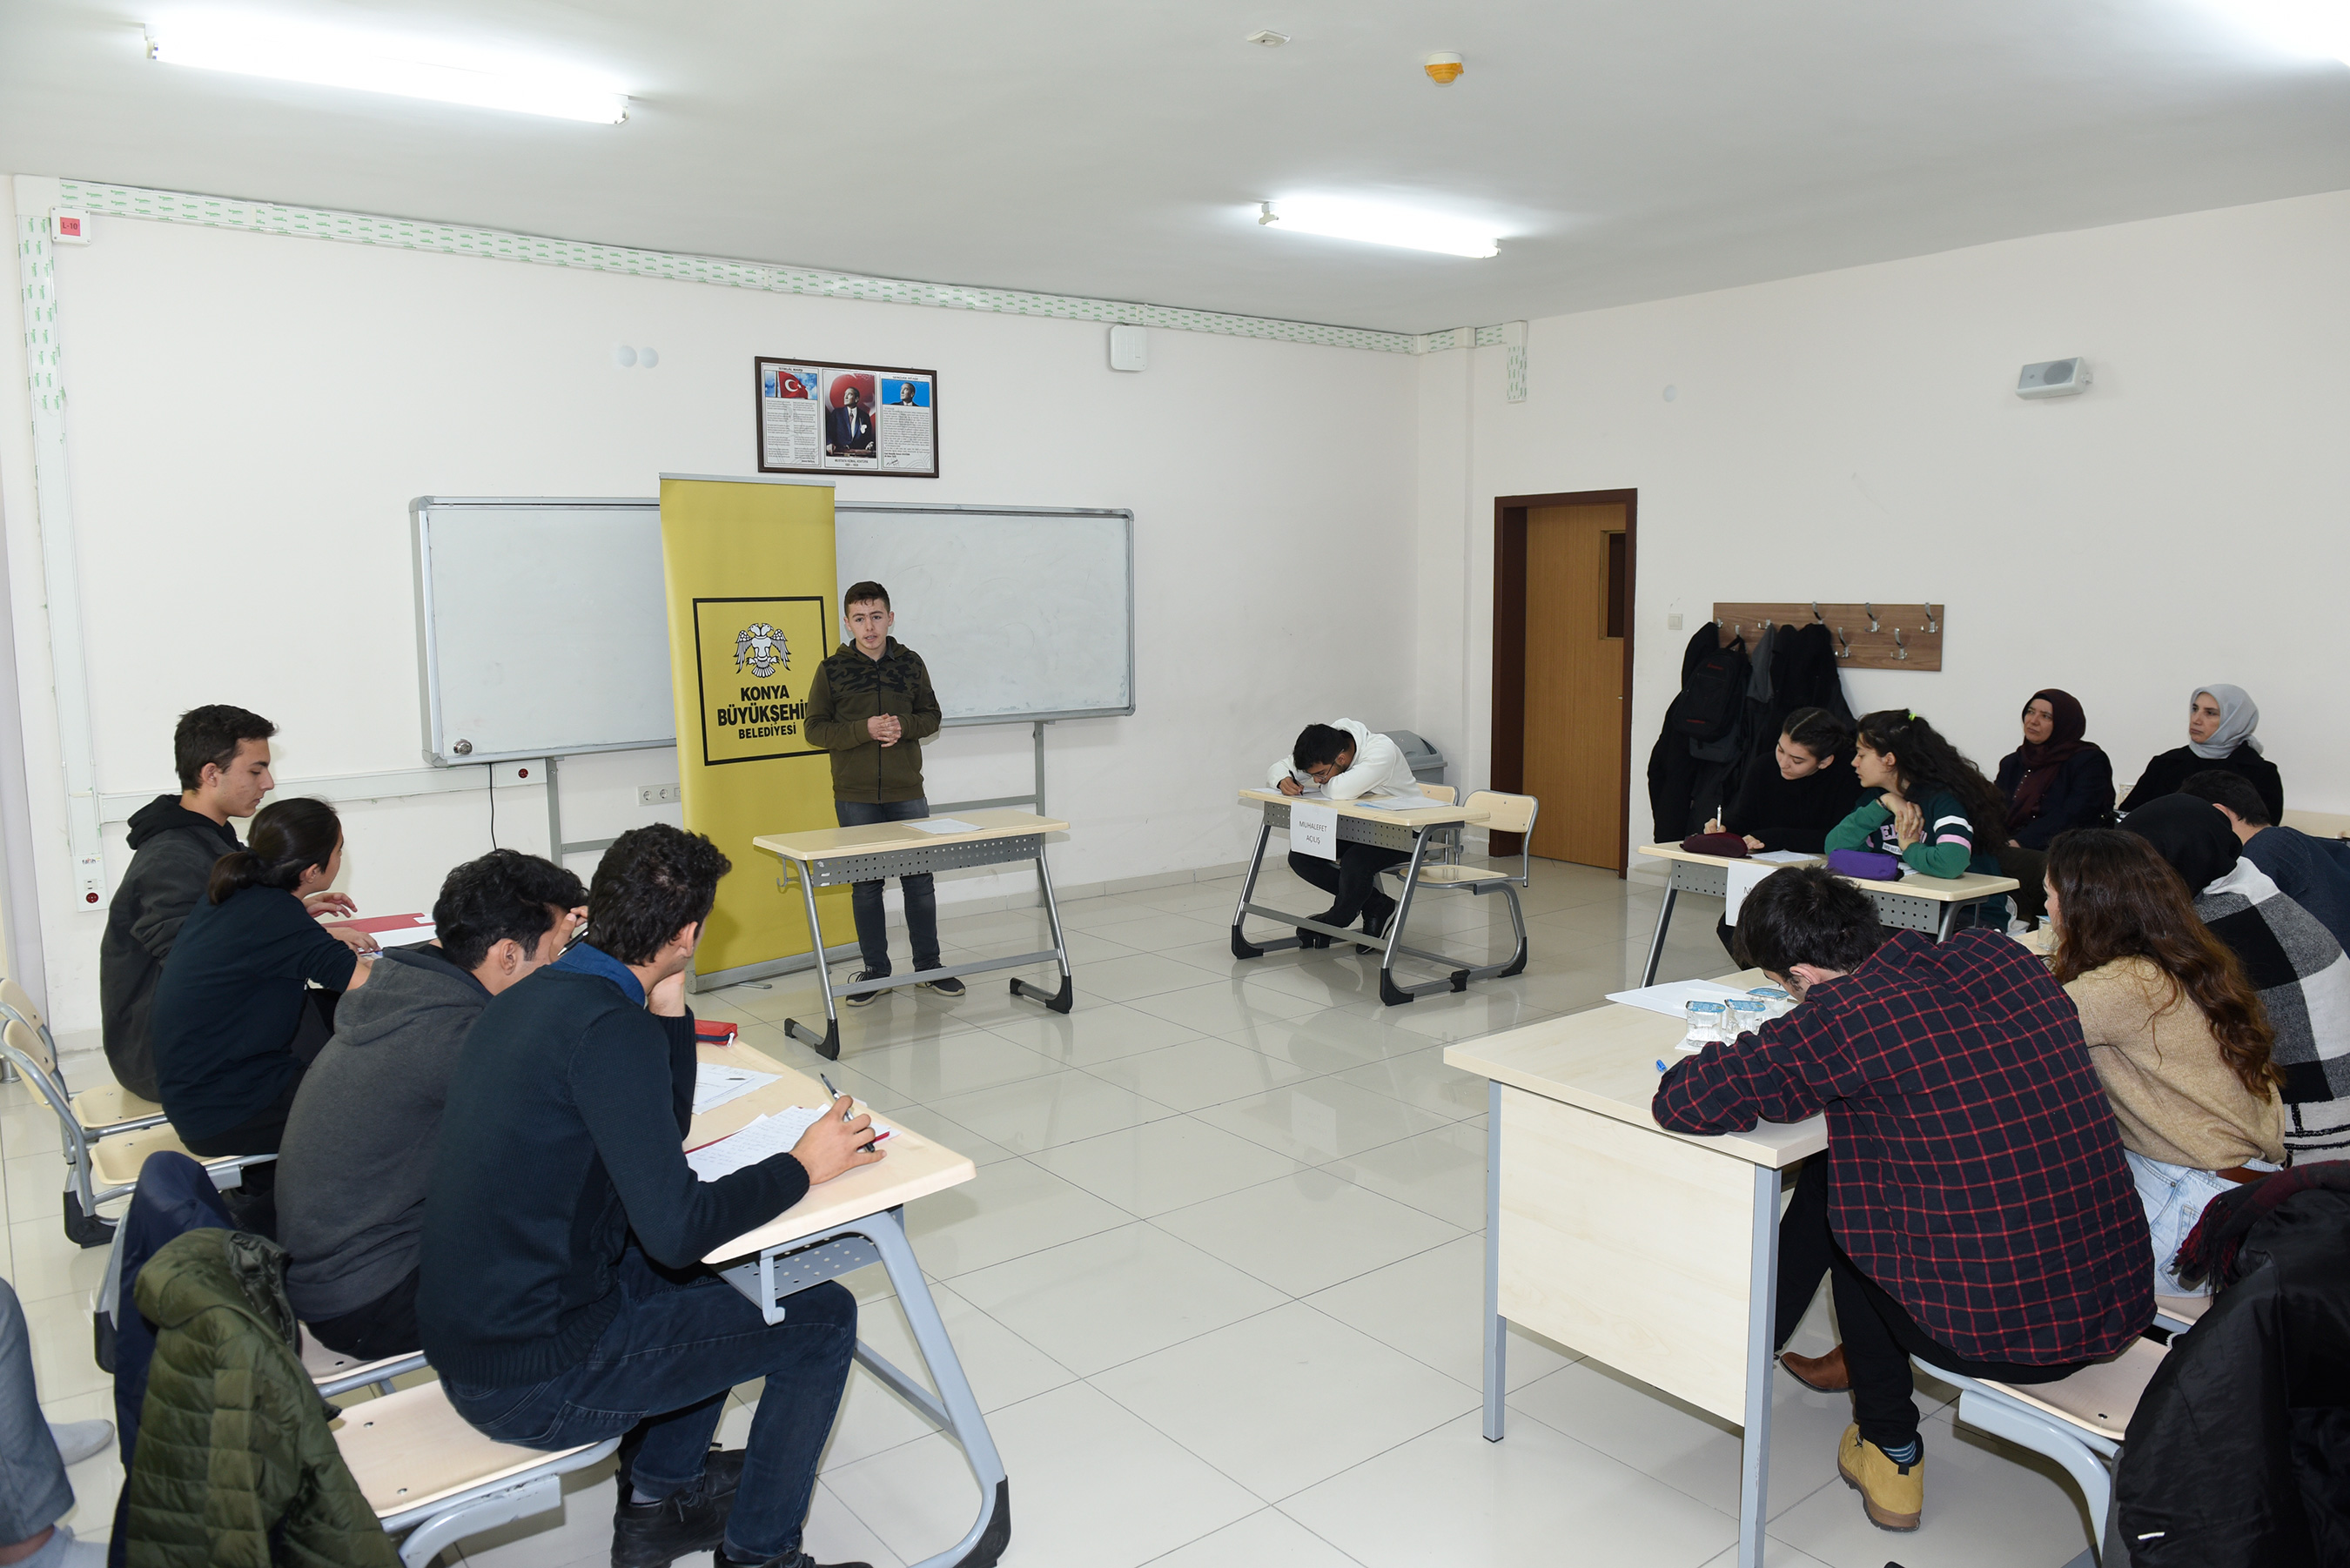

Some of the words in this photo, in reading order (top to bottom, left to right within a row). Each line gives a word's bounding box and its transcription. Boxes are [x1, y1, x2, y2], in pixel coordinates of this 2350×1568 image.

[62, 222, 78, 231] L-10
[741, 685, 789, 701] KONYA
[716, 699, 809, 727] BÜYÜKŞEHİ
[738, 721, 796, 740] BELEDİYESİ
[1299, 821, 1327, 833] MUHALEFET
